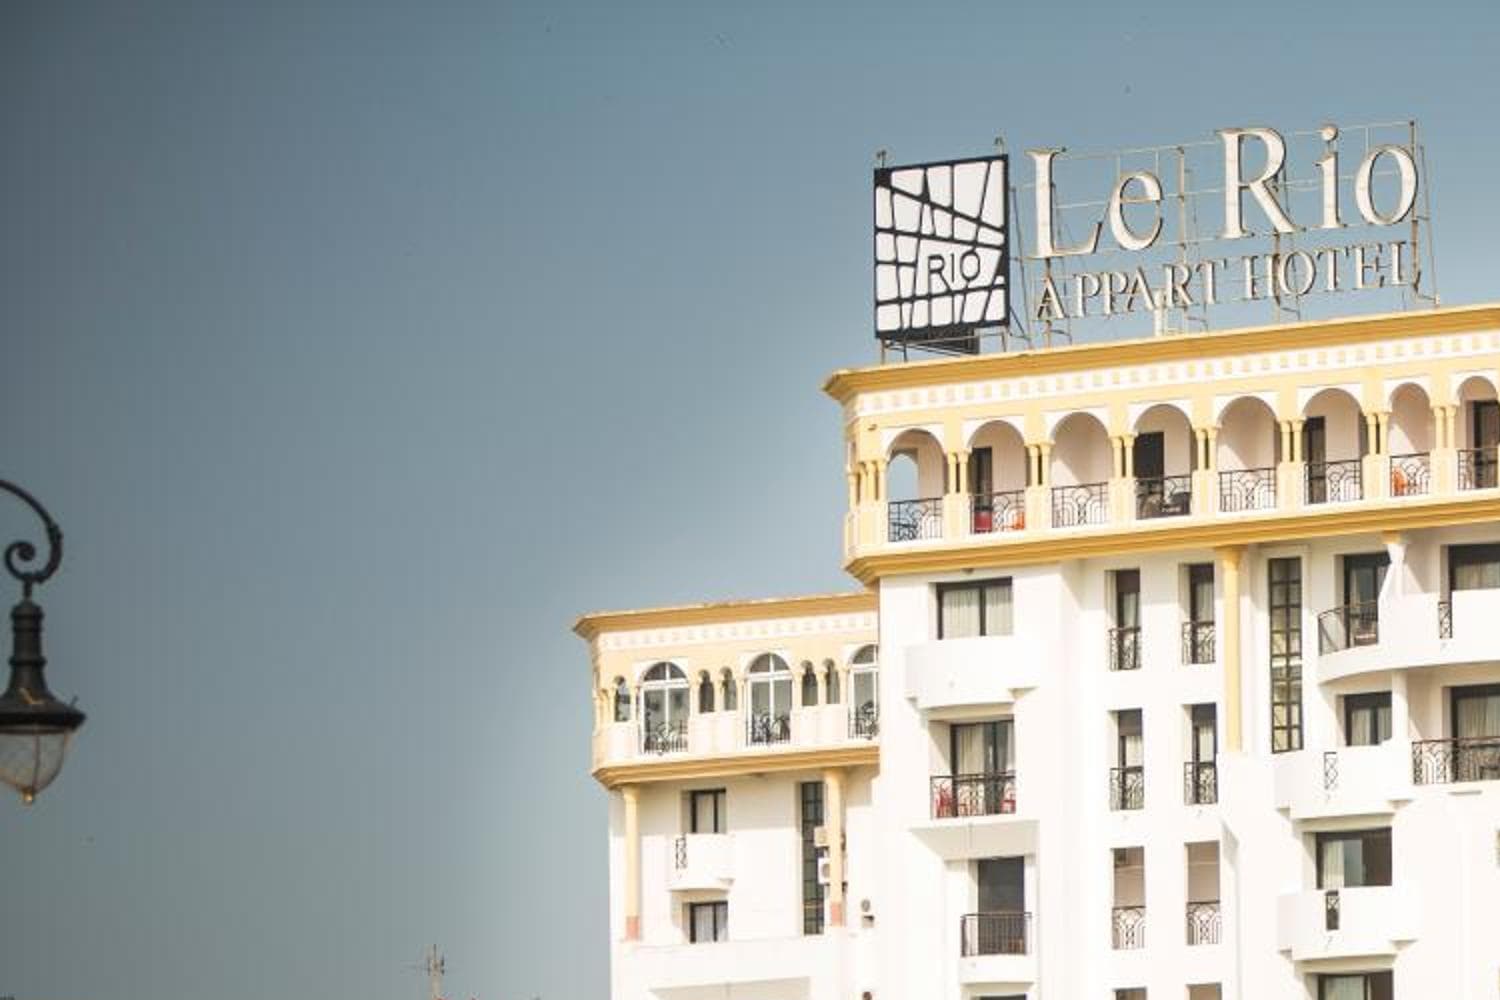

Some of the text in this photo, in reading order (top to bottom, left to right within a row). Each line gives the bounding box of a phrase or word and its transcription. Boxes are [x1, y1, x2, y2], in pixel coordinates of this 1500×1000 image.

[1024, 124, 1419, 258] Le Rio
[927, 250, 981, 297] RIO
[1035, 241, 1409, 321] APPART HOTEL
